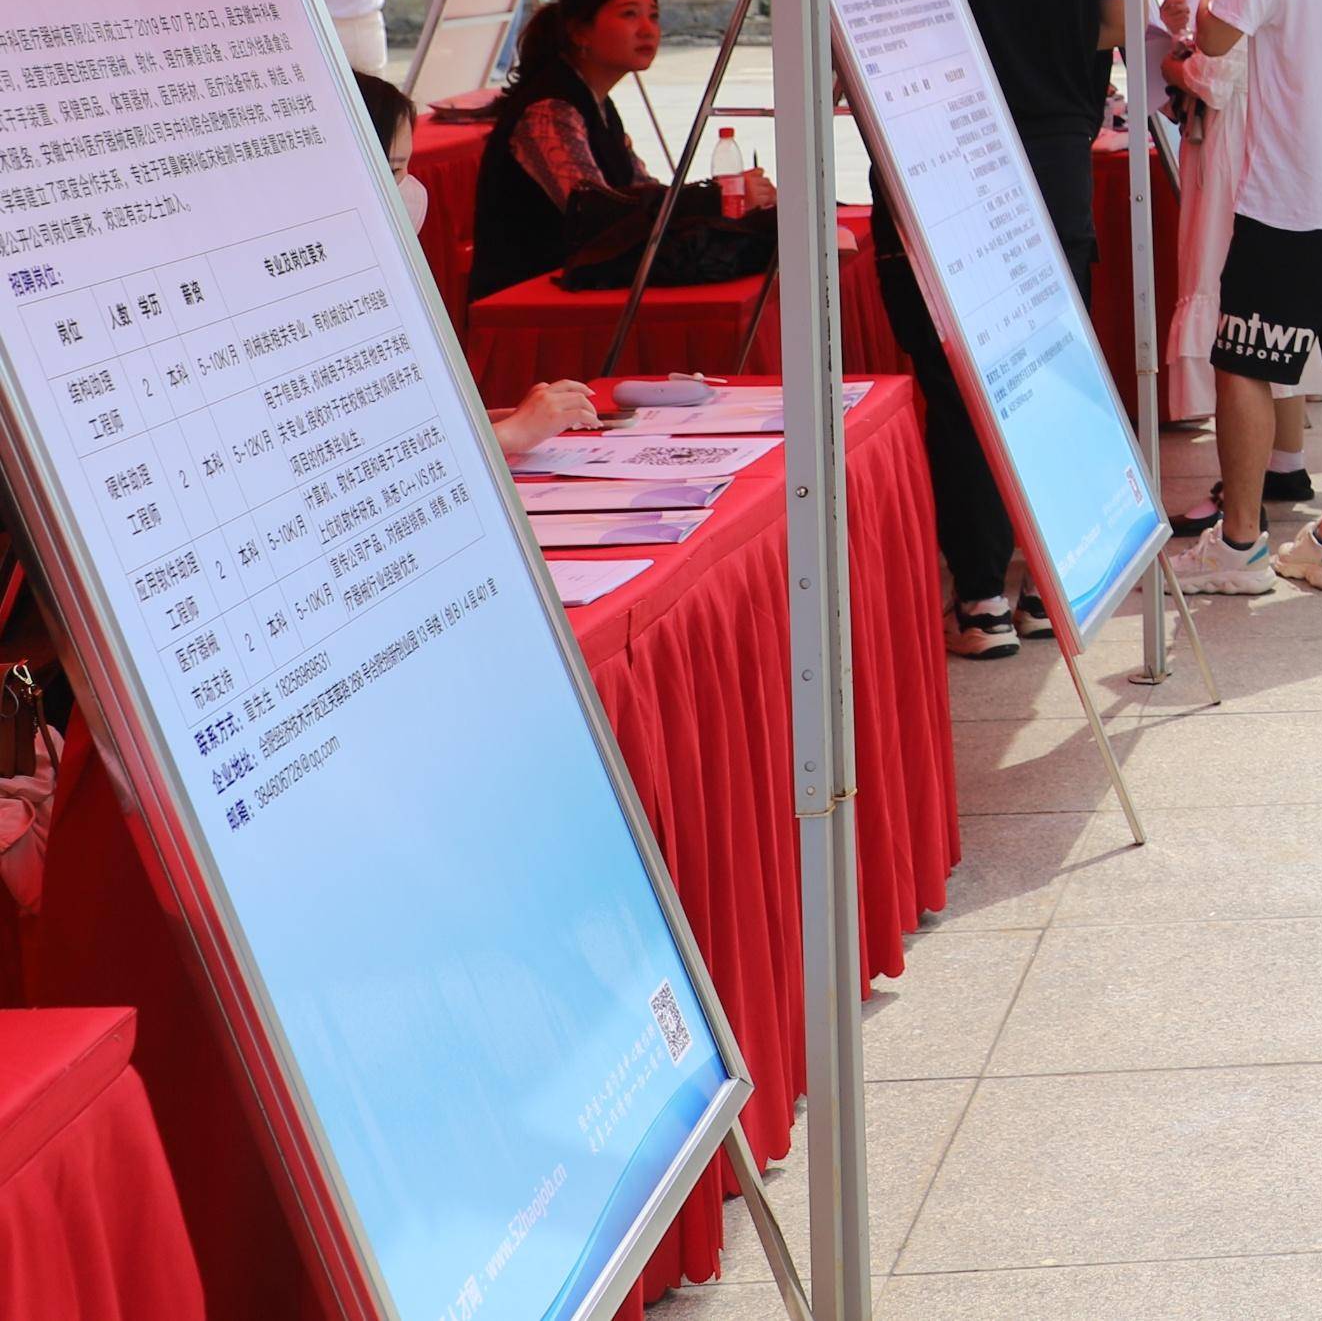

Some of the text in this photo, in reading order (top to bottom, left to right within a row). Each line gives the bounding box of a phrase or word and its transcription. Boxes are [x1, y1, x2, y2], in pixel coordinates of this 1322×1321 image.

[264, 242, 327, 277] 专业及岗位要求
[179, 280, 205, 305] 薪资
[108, 303, 133, 330] 人数
[138, 293, 162, 319] 学历
[55, 319, 83, 345] 岗位
[1235, 344, 1294, 364] SPORT
[67, 369, 116, 404] 结构助理
[142, 378, 154, 397] 2
[166, 364, 189, 387] 本科
[88, 408, 124, 440] 工程师
[202, 453, 224, 477] 本科
[104, 463, 153, 500] 硬件助理
[178, 470, 190, 489] 2
[127, 502, 161, 536] 工程师
[238, 539, 260, 566] 本科
[135, 551, 200, 602] 应用软件助理
[215, 560, 226, 580] 2
[165, 595, 199, 631] 工程师
[266, 612, 287, 637] 本科
[175, 630, 221, 673] 医疗器械
[244, 633, 255, 652] 2
[190, 669, 234, 709] 市场支持
